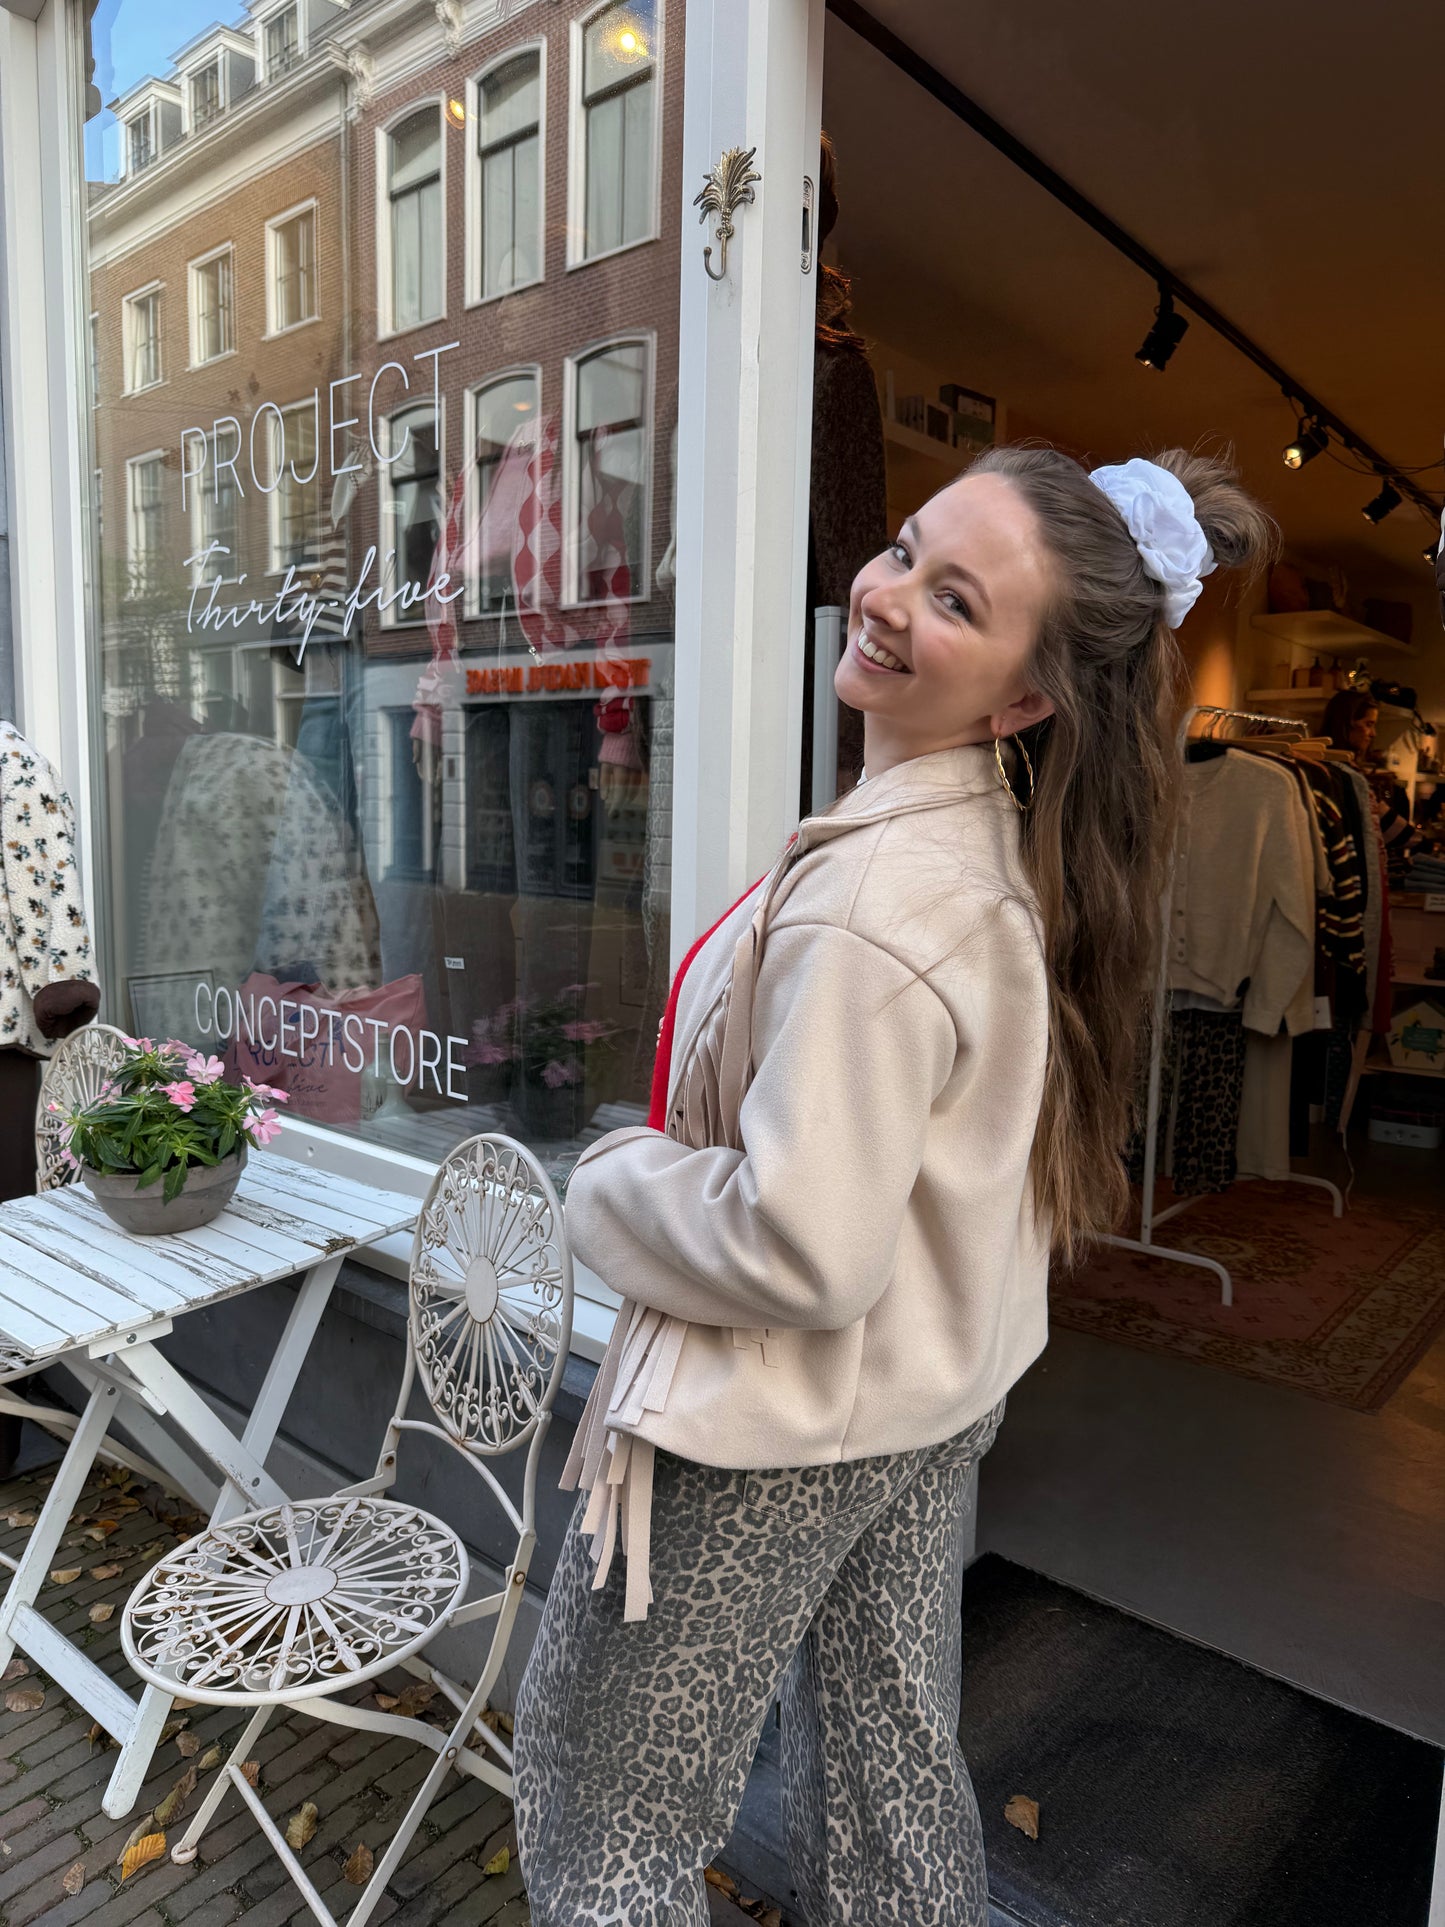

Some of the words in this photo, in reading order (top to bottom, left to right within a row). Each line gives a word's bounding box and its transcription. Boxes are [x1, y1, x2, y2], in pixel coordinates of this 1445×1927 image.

[180, 340, 461, 513] PROJECT
[183, 540, 465, 666] Thirty-five
[195, 982, 469, 1101] CONCEPTSTORE
